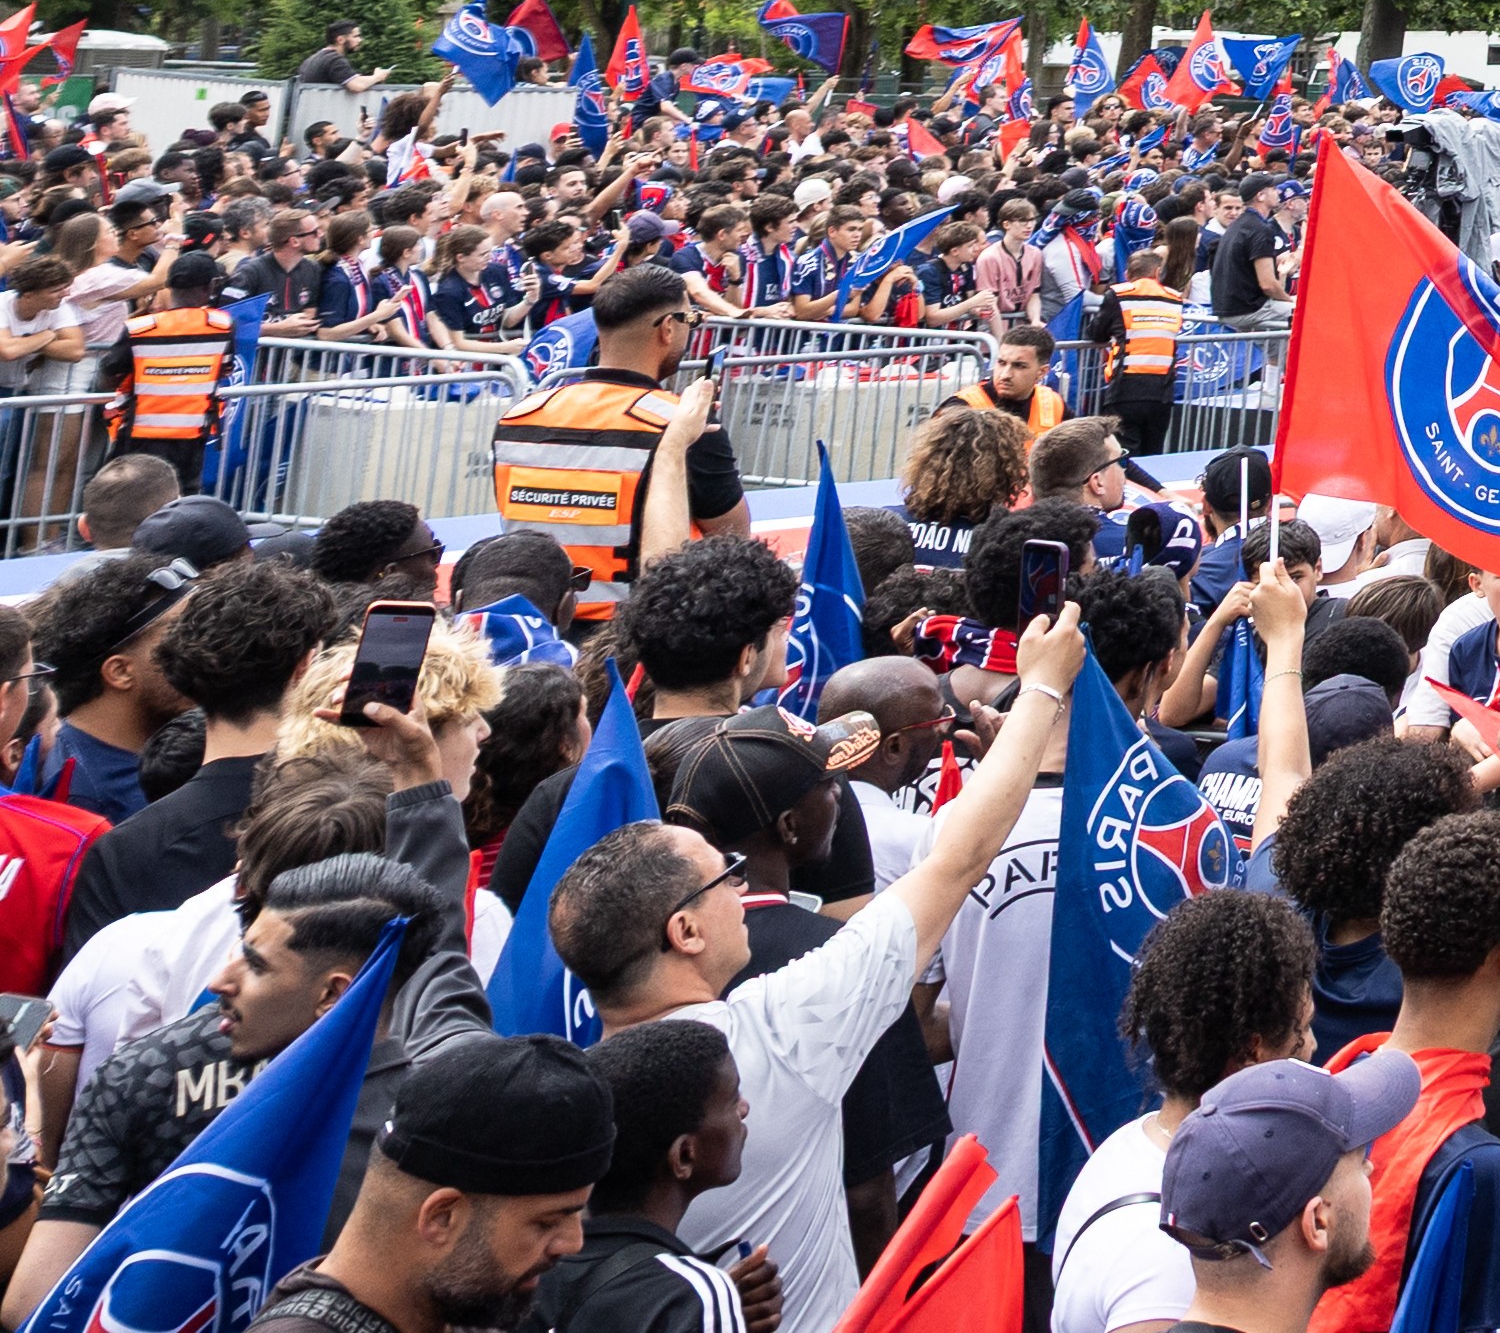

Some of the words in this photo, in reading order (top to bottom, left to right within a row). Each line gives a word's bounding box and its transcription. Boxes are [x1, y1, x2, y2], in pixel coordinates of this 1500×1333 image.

[1426, 422, 1465, 483] SAINT
[511, 488, 569, 505] SÉCURITÉ
[571, 490, 616, 508] PRIVÉE
